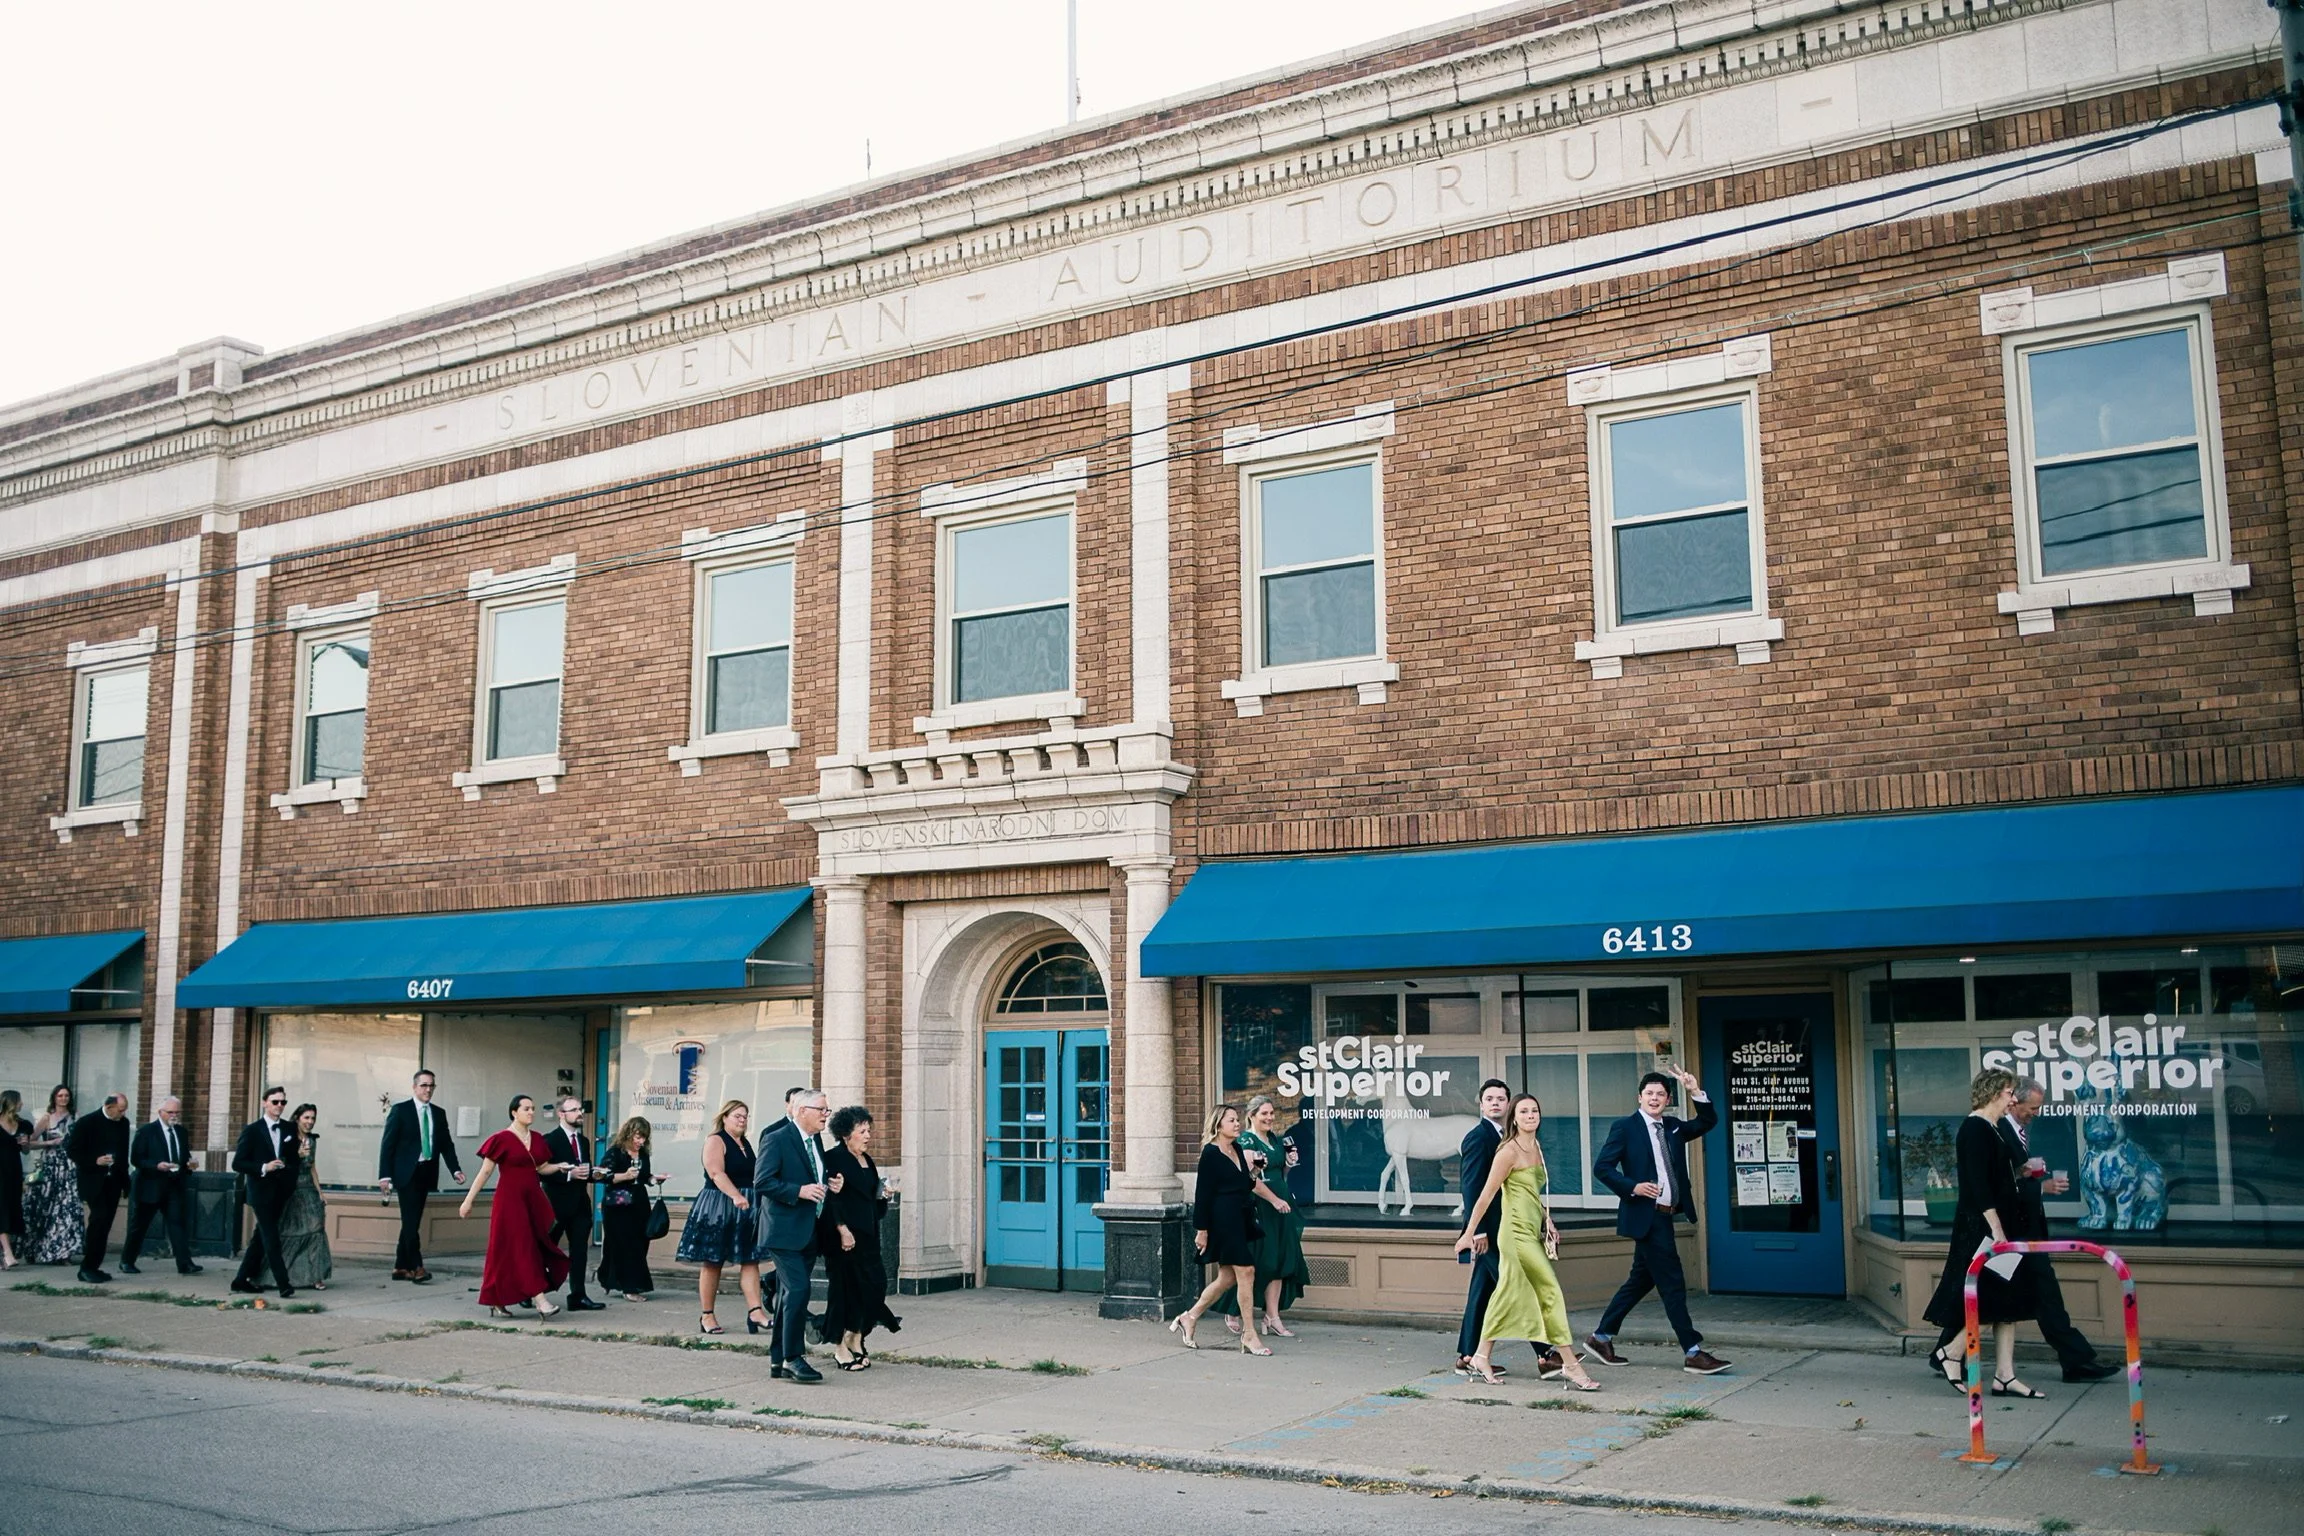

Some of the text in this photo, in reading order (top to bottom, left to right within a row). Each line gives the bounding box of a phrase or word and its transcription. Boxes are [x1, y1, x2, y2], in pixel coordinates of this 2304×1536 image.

[500, 108, 1697, 430] SLOVENIAN AUDITORIUM
[841, 808, 1128, 849] SLOVENSKI NARODNI DOM
[1602, 924, 1693, 954] 6413
[407, 979, 453, 999] 6407
[2011, 1013, 2186, 1058] stClair
[1298, 1034, 1425, 1070] stClair
[1741, 1040, 1793, 1054] stClair
[1732, 1051, 1804, 1067] Superior
[643, 1080, 678, 1095] Slovenian
[1277, 1062, 1451, 1106] Superior
[1731, 1077, 1748, 1085] 6413
[1763, 1076, 1781, 1085] Clair
[1783, 1076, 1809, 1085] Avenue
[1770, 1086, 1786, 1094] Ohio
[1789, 1086, 1810, 1094] 44103
[633, 1092, 706, 1110] Museum & Archives
[2038, 1103, 2197, 1117] ELOPMENT CORPORATION
[1302, 1109, 1430, 1120] DEVELOPMENT CORPORATION
